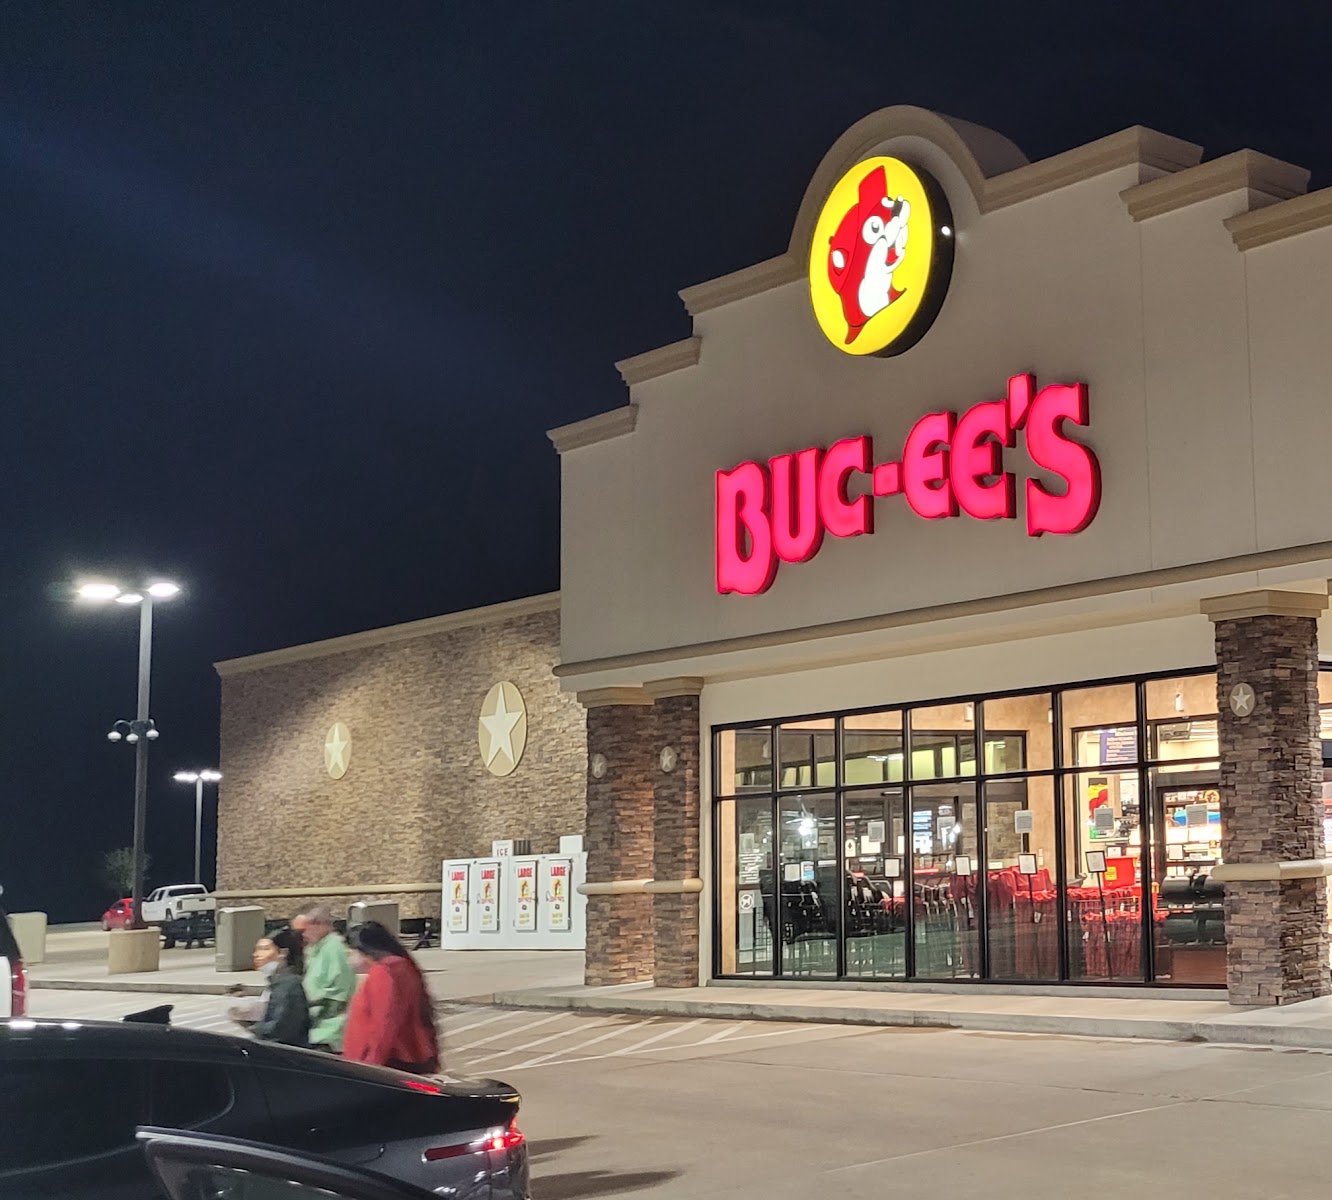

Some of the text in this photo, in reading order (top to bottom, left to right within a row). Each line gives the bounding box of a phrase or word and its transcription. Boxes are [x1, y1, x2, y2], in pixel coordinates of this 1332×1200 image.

[716, 373, 1102, 596] BUC-EE'S
[497, 848, 508, 856] ICE
[481, 869, 495, 879] LARGE
[518, 867, 532, 878] LARGE
[551, 866, 566, 876] LARGE
